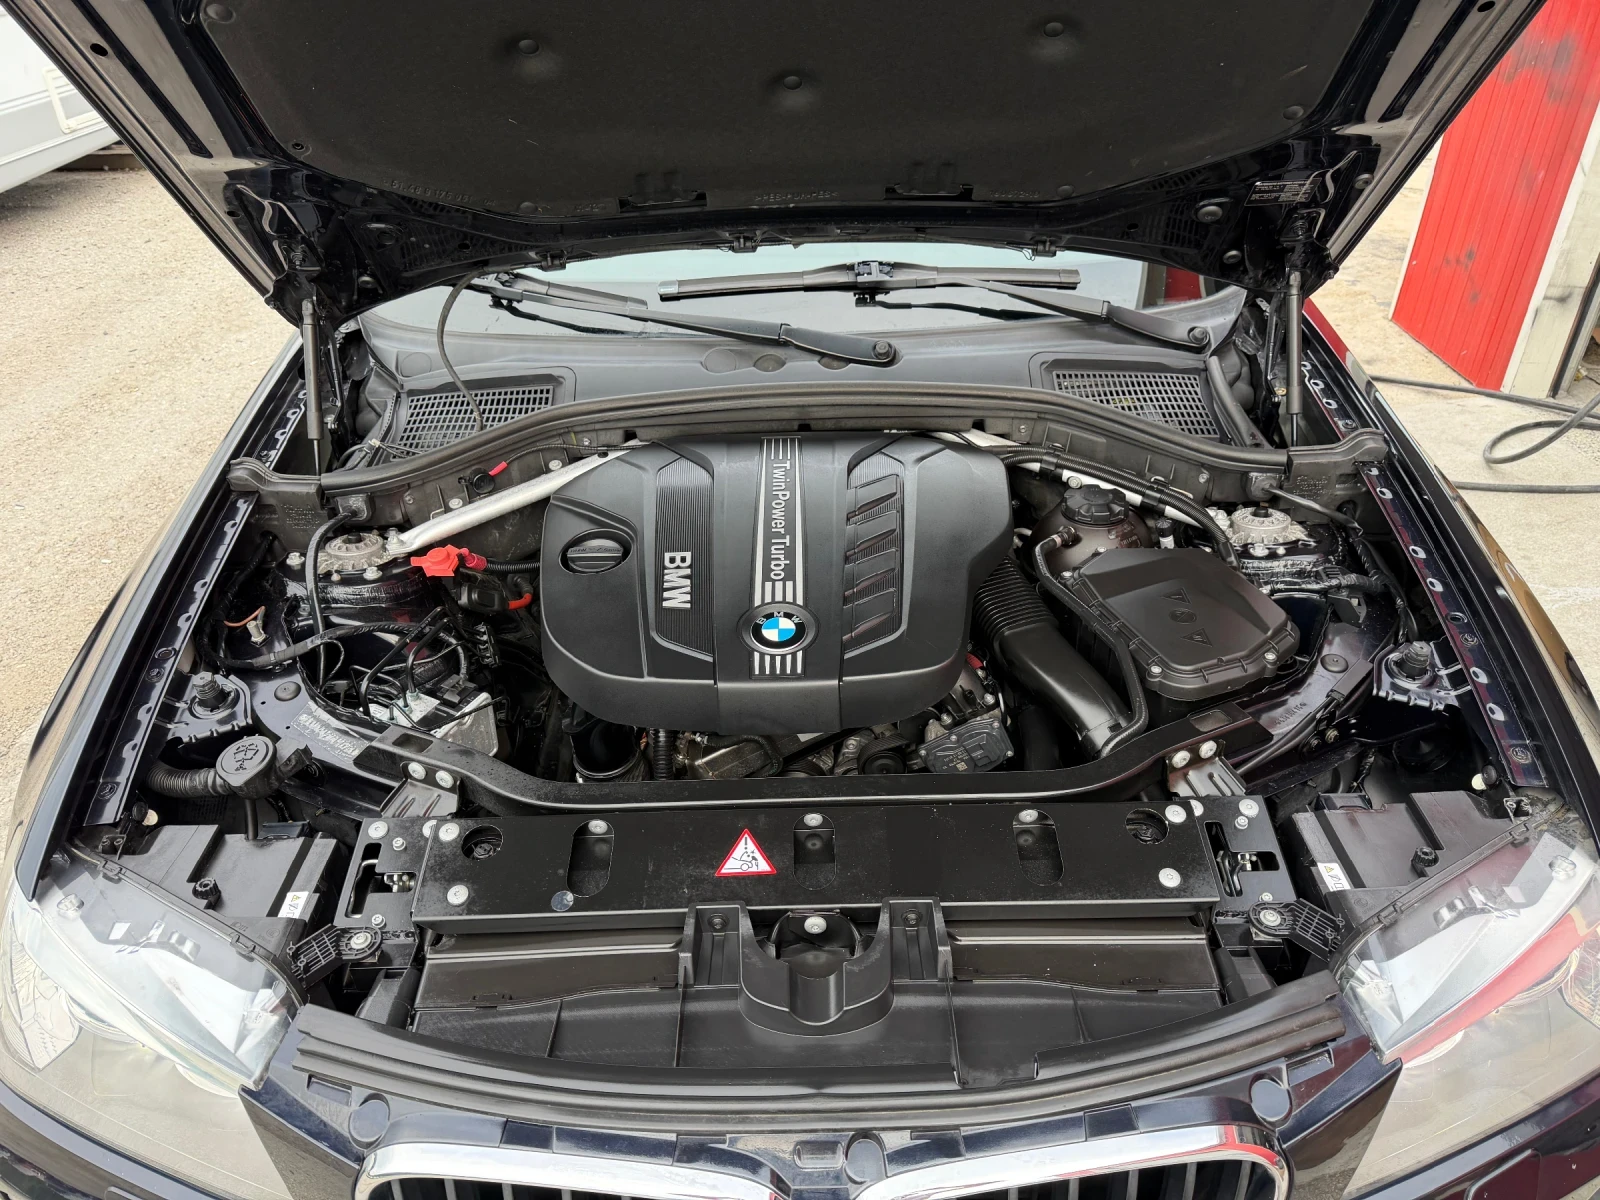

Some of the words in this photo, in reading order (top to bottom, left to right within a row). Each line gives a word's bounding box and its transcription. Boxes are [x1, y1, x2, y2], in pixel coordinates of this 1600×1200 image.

[772, 461, 790, 533] TwinPower
[663, 552, 692, 608] BMW
[770, 536, 789, 580] Turbo
[756, 611, 803, 625] BMW
